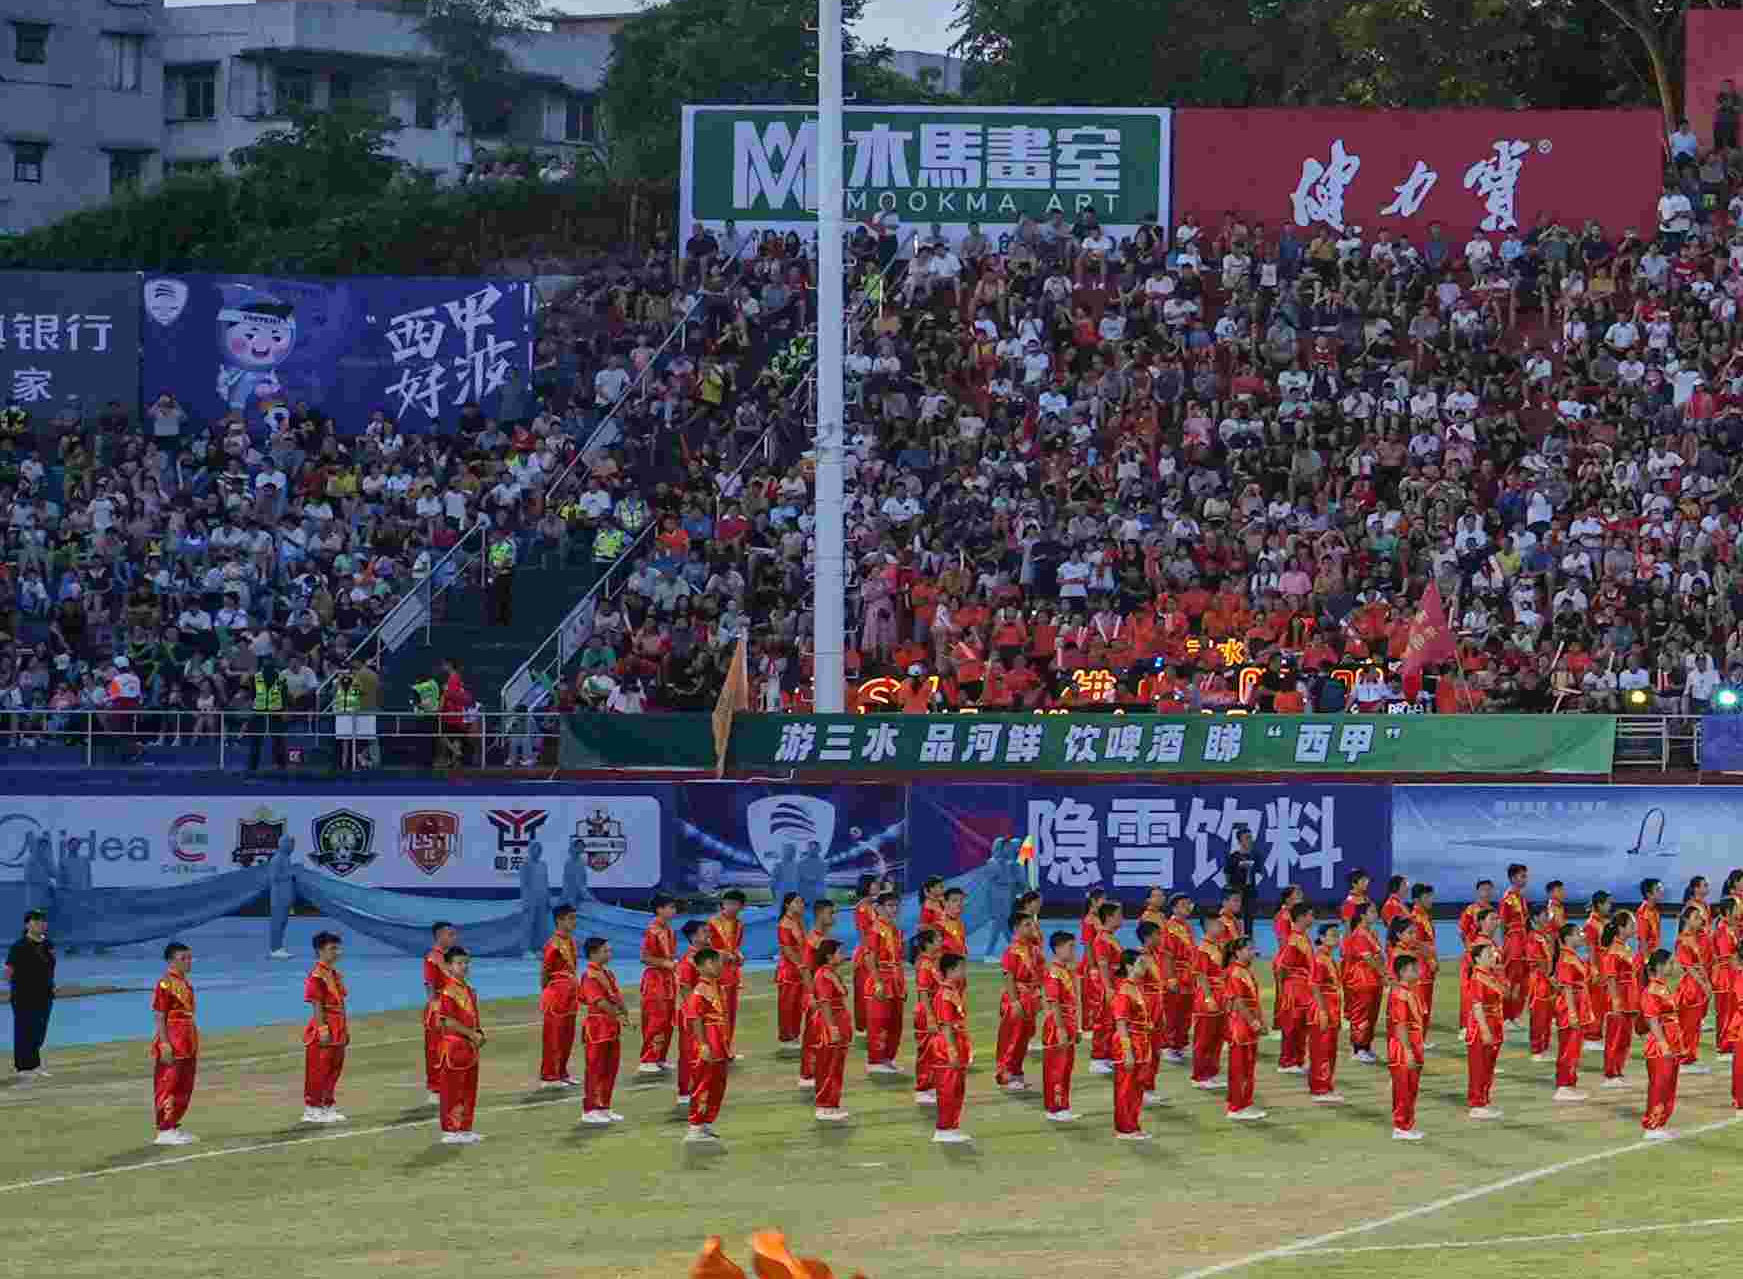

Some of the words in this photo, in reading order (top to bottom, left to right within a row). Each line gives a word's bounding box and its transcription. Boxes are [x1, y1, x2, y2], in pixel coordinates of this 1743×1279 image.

[848, 124, 1120, 189] 木馬畫室
[847, 193, 1016, 212] MOOKMA
[1046, 194, 1120, 213] ART
[13, 368, 53, 403] 家
[775, 721, 898, 764] 游三水
[919, 722, 1042, 764] 品河鲜
[1063, 722, 1186, 764] 饮啤酒
[1027, 797, 1343, 890] 隐雪饮料
